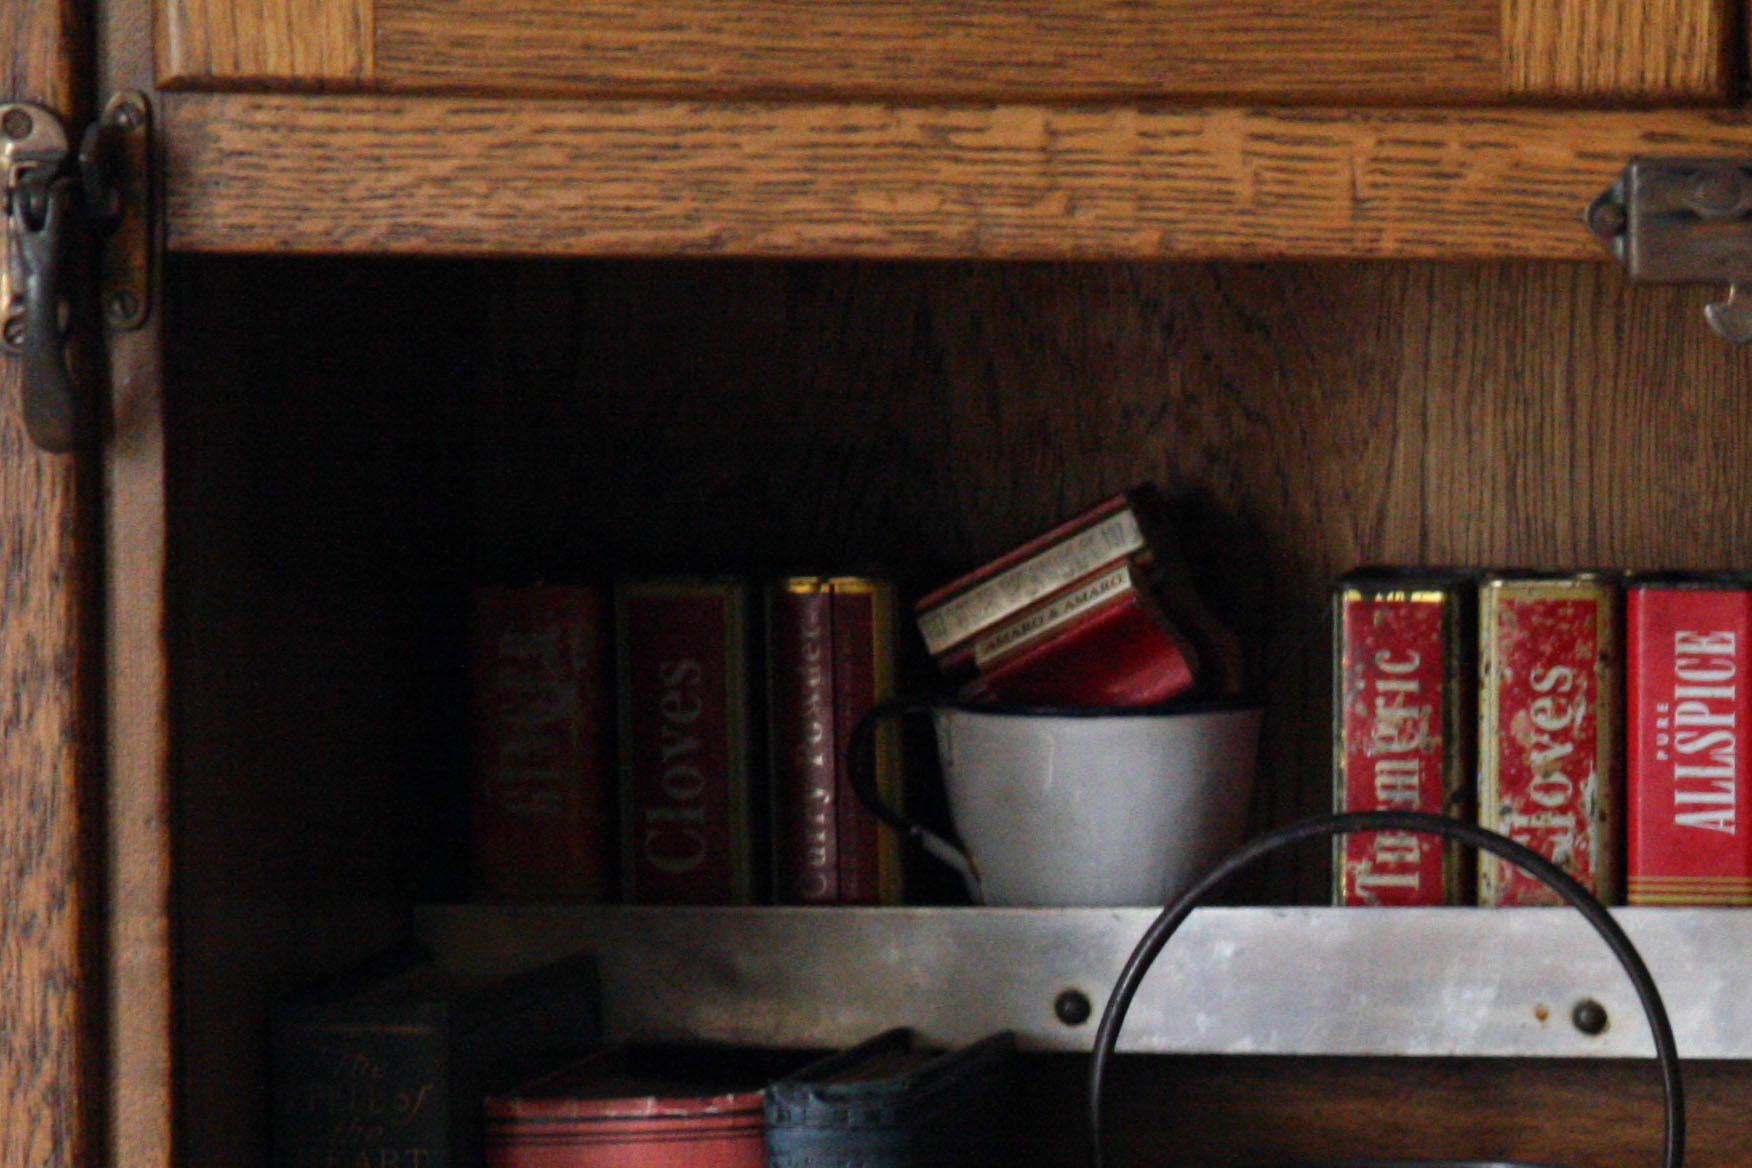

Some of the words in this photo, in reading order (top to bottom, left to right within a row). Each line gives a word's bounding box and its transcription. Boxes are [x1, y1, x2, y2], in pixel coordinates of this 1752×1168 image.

[1064, 573, 1124, 611] AMARO
[642, 656, 708, 874] Cloves
[1355, 650, 1421, 904] Tumeric
[1656, 701, 1670, 761] PURE
[1673, 629, 1737, 836] ALLSPICE
